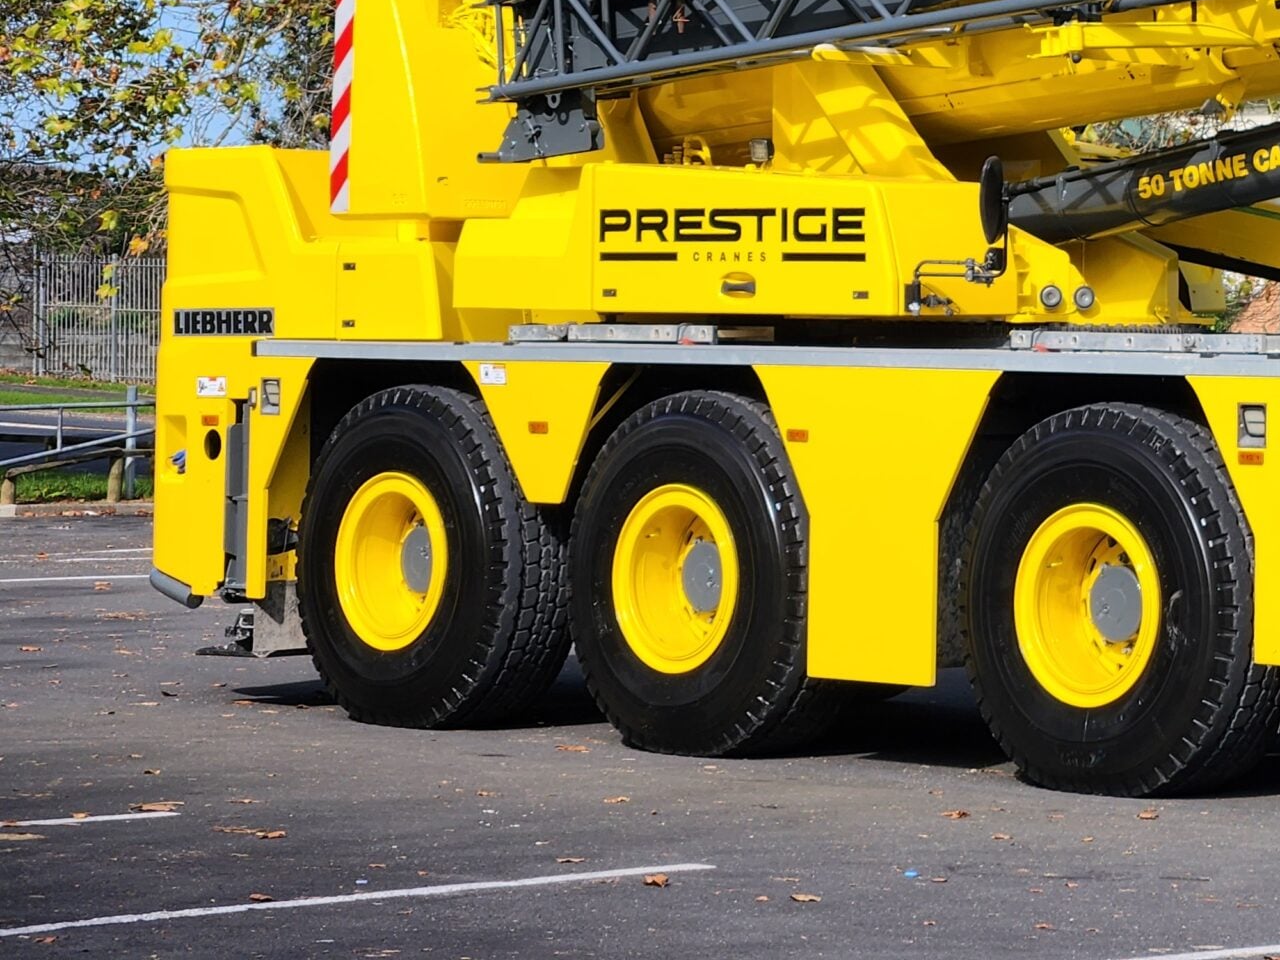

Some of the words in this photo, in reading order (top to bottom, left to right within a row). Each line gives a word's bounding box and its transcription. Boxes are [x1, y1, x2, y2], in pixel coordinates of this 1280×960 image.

[1138, 174, 1165, 200] 50
[1169, 153, 1249, 192] TONNE
[599, 207, 866, 242] PRESTIGE
[692, 251, 767, 262] CRANES
[174, 310, 273, 334] LIEBHERR
